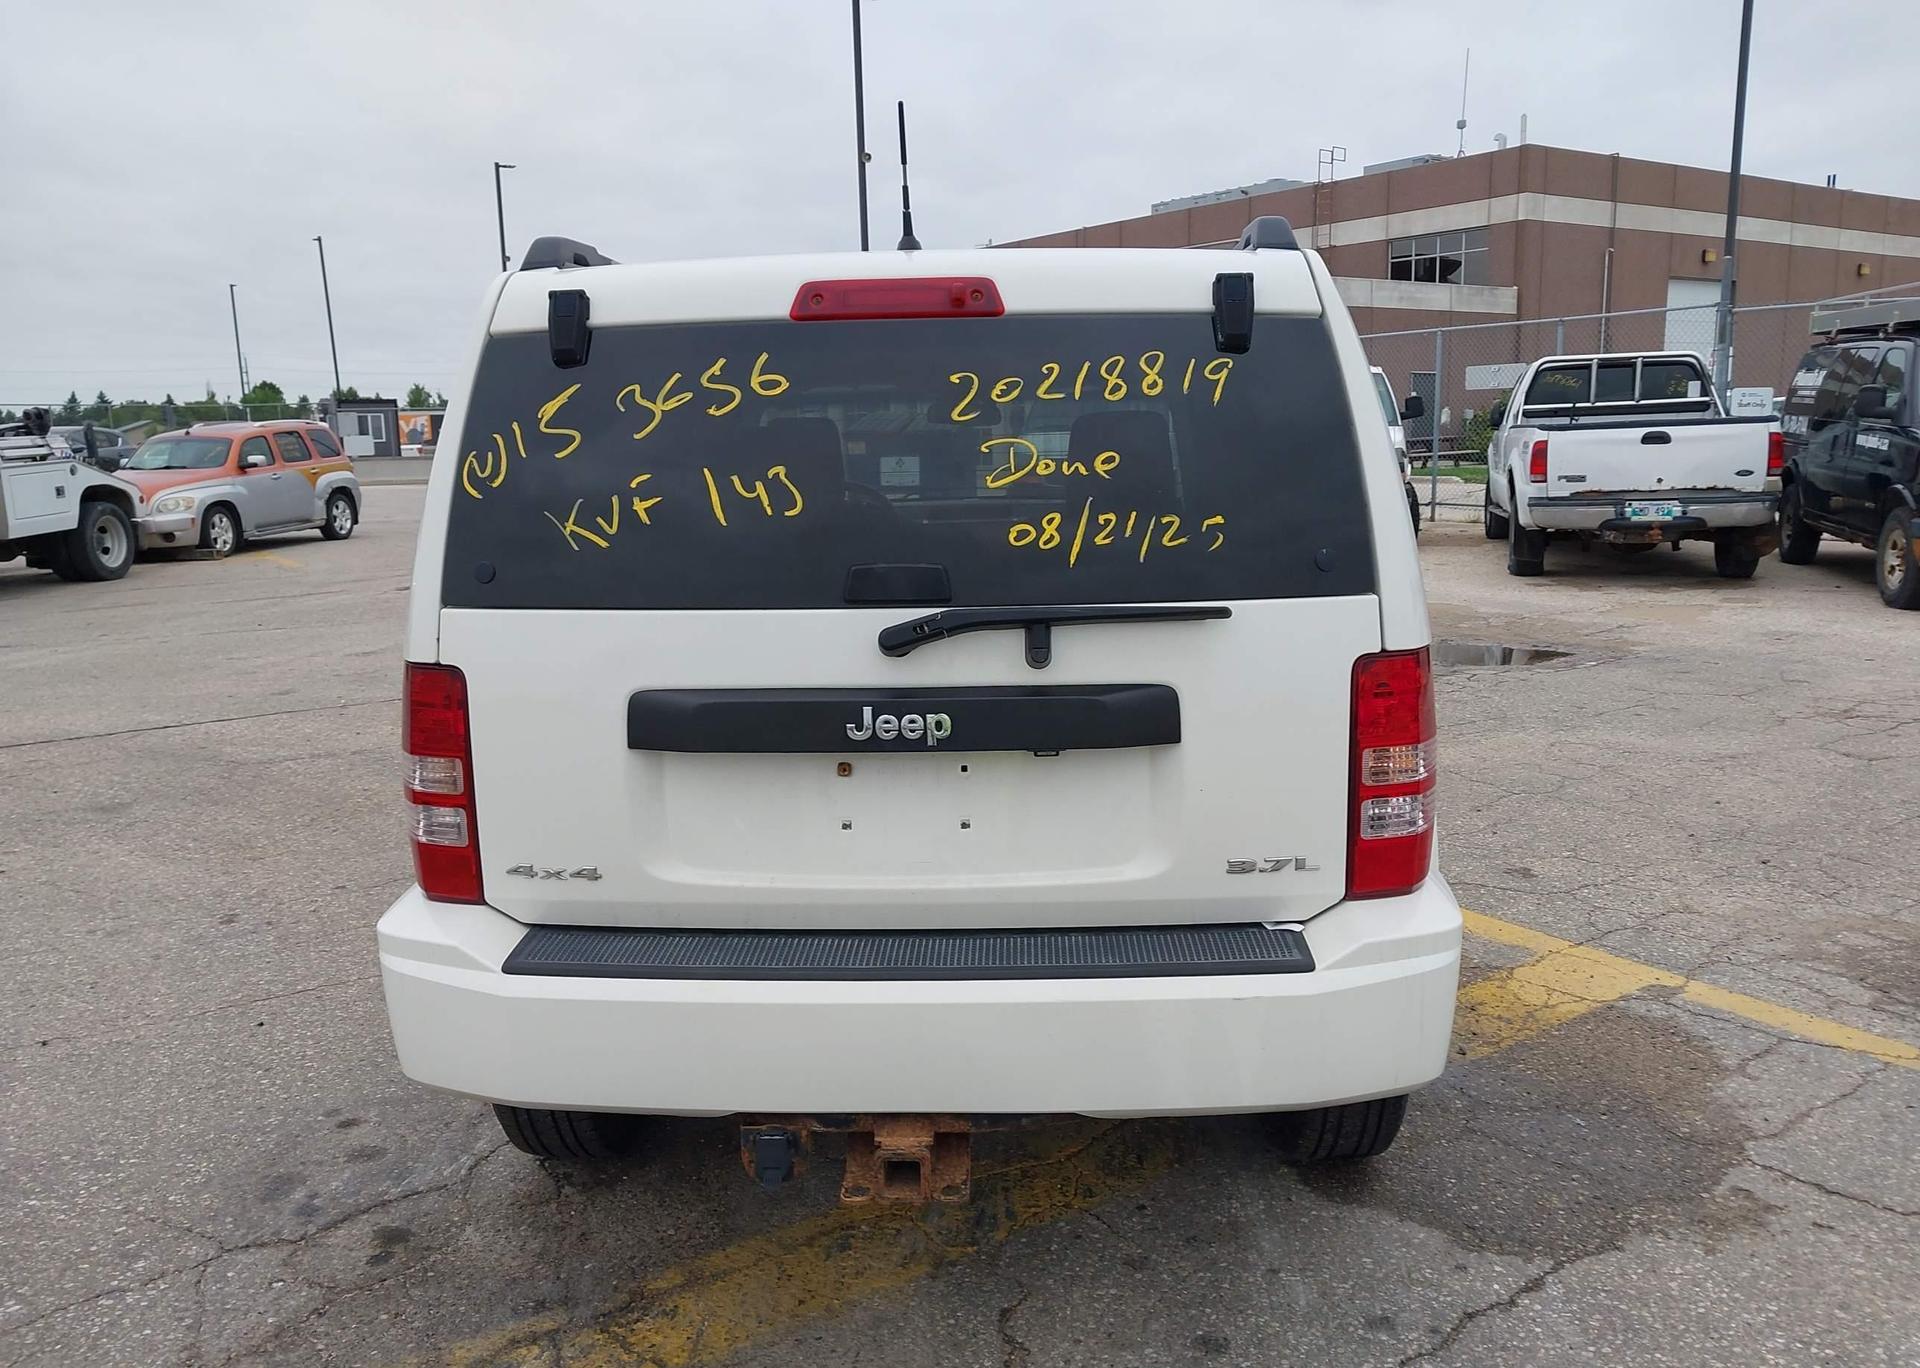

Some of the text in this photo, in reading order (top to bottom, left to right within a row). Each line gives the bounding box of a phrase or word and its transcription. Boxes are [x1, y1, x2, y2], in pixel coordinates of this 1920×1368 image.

[948, 350, 1233, 423] 20218819
[979, 436, 1121, 489] Done
[1007, 496, 1226, 568] 08/21/25
[846, 706, 952, 746] Jeep
[505, 863, 603, 881] 4x4
[1226, 856, 1320, 874] 3.7L
